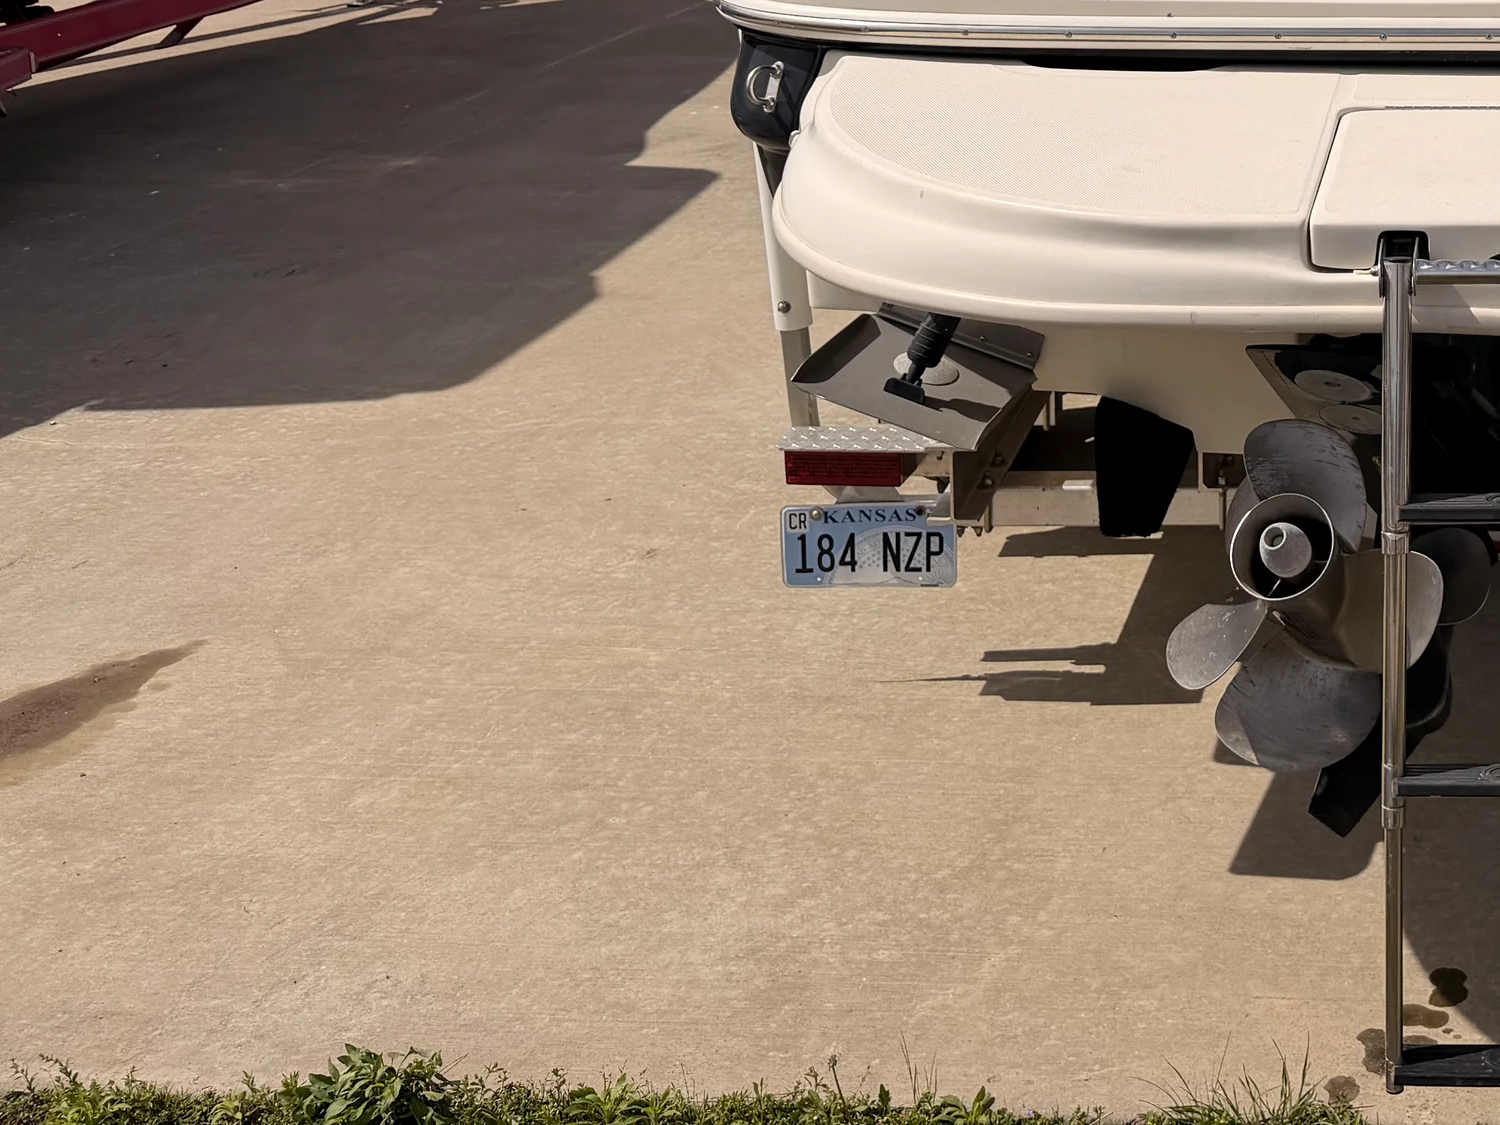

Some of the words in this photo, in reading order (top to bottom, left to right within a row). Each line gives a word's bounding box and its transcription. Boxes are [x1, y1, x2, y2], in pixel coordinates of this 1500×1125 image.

[789, 513, 807, 529] CR
[823, 508, 917, 524] KANSAS
[795, 532, 858, 573] 184
[882, 531, 944, 572] NZP
